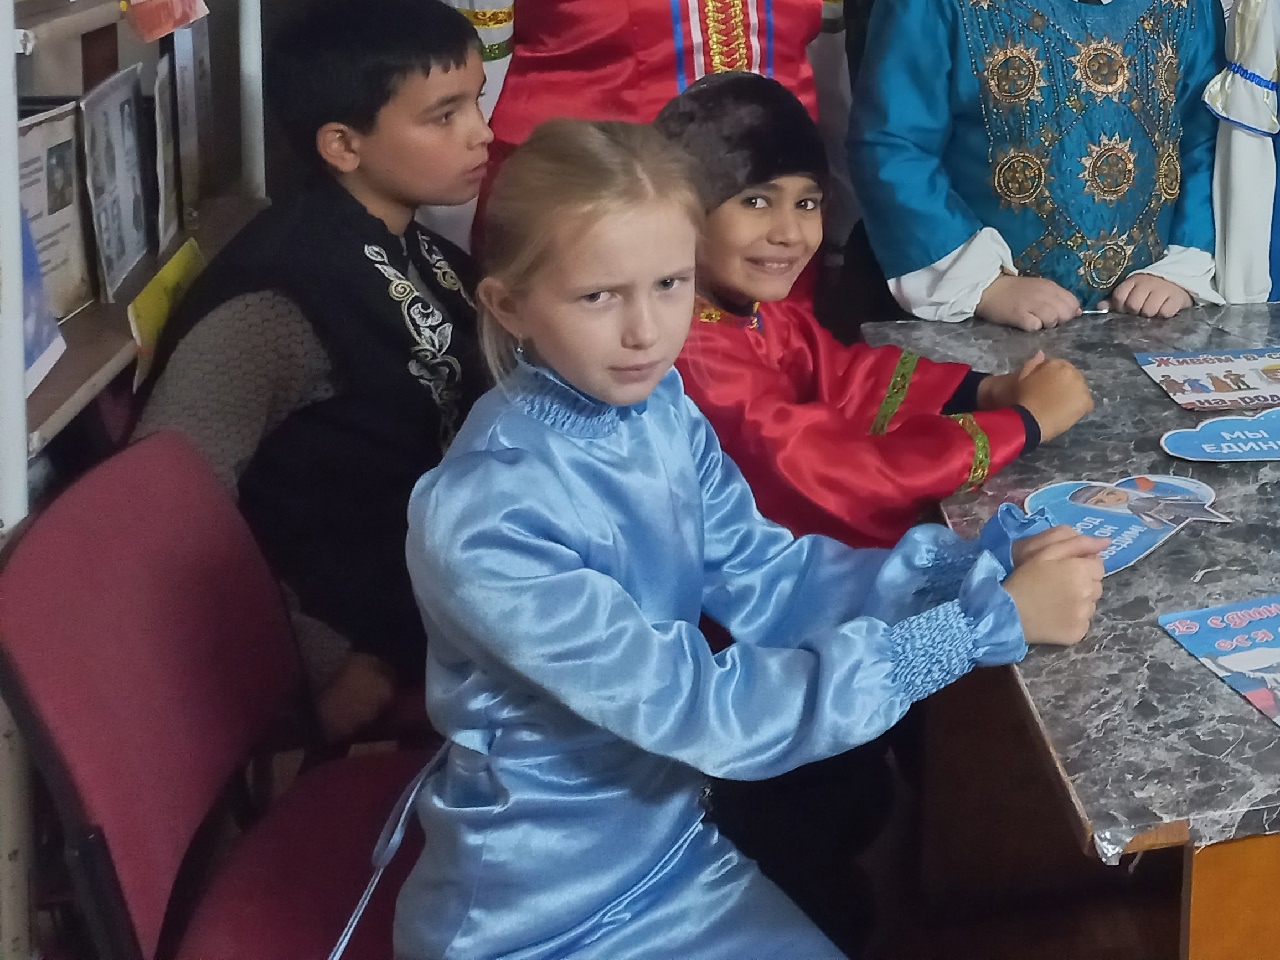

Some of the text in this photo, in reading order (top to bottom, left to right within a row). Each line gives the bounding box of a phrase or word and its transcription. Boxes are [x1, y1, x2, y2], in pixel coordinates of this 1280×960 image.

[1154, 354, 1234, 368] Живём
[1241, 353, 1259, 362] в
[1195, 397, 1229, 407] на
[1220, 429, 1269, 440] МЫ
[1166, 618, 1200, 636] В
[1214, 628, 1274, 651] вся
